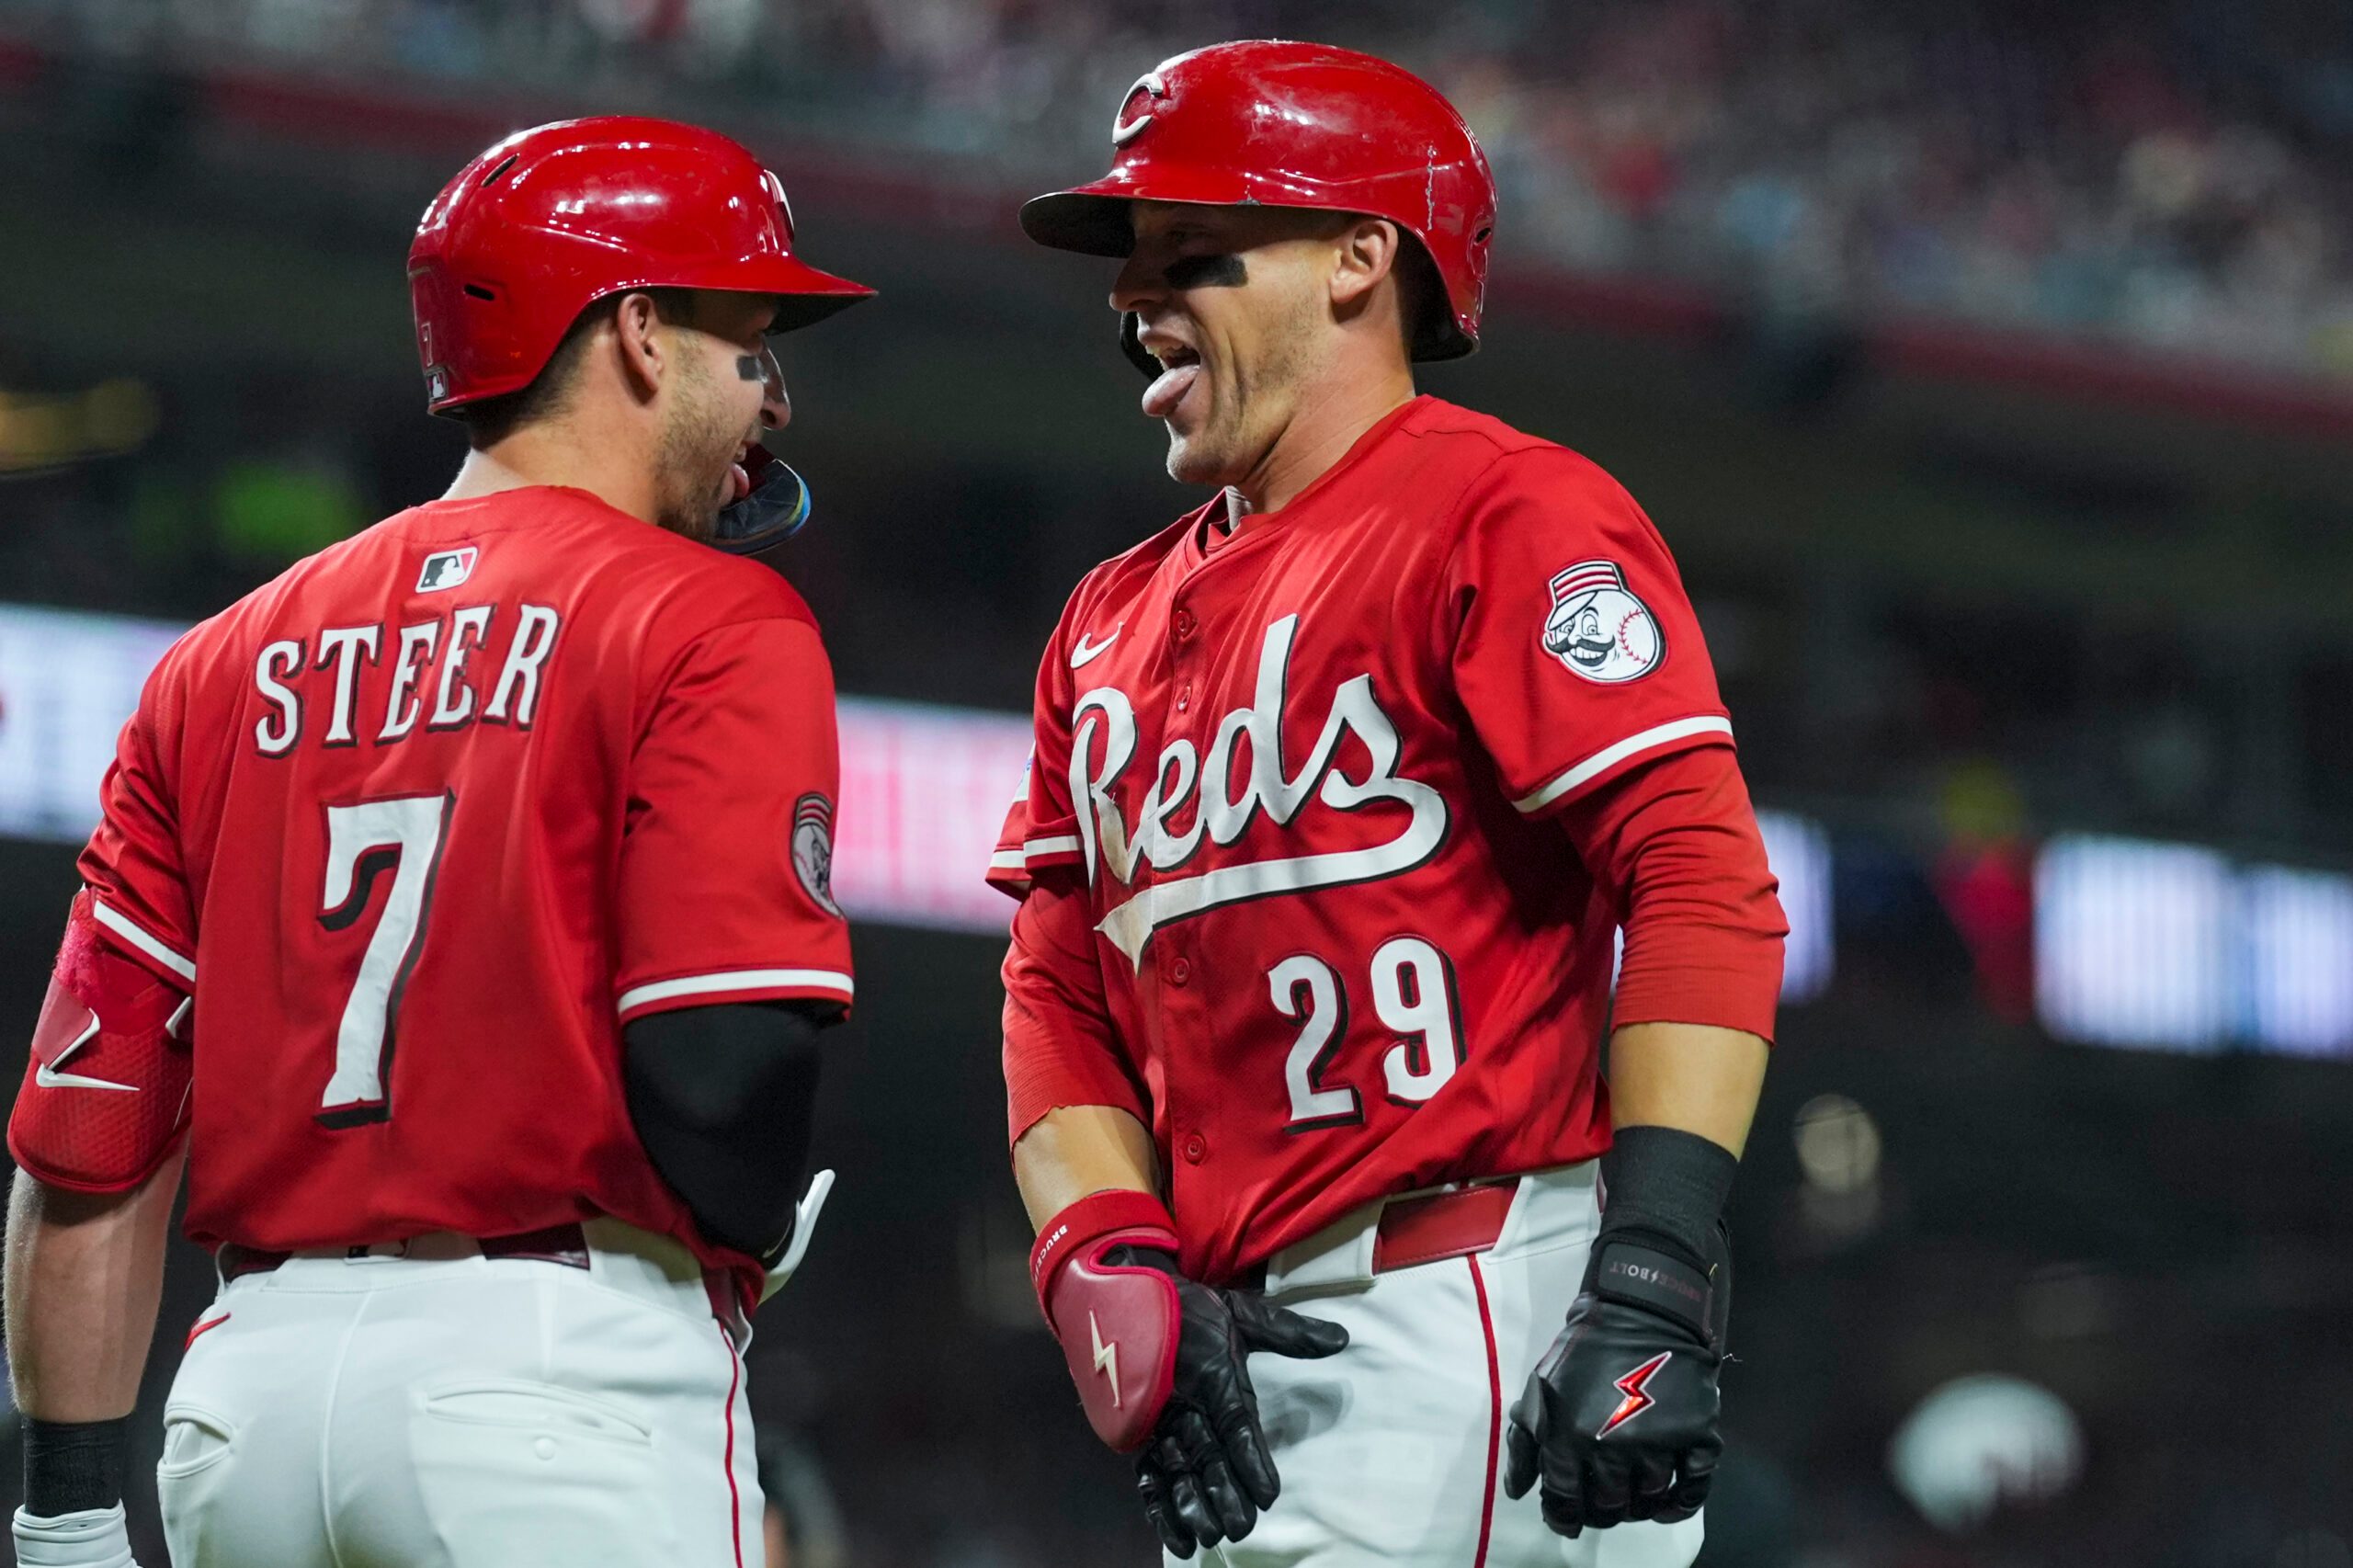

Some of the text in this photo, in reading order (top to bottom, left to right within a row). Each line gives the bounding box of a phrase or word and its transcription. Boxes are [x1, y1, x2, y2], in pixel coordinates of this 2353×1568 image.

[1111, 73, 1164, 147] C
[255, 603, 562, 759] STEER
[1069, 612, 1452, 976] Reds
[314, 787, 454, 1131] 7
[1267, 933, 1467, 1134] 29
